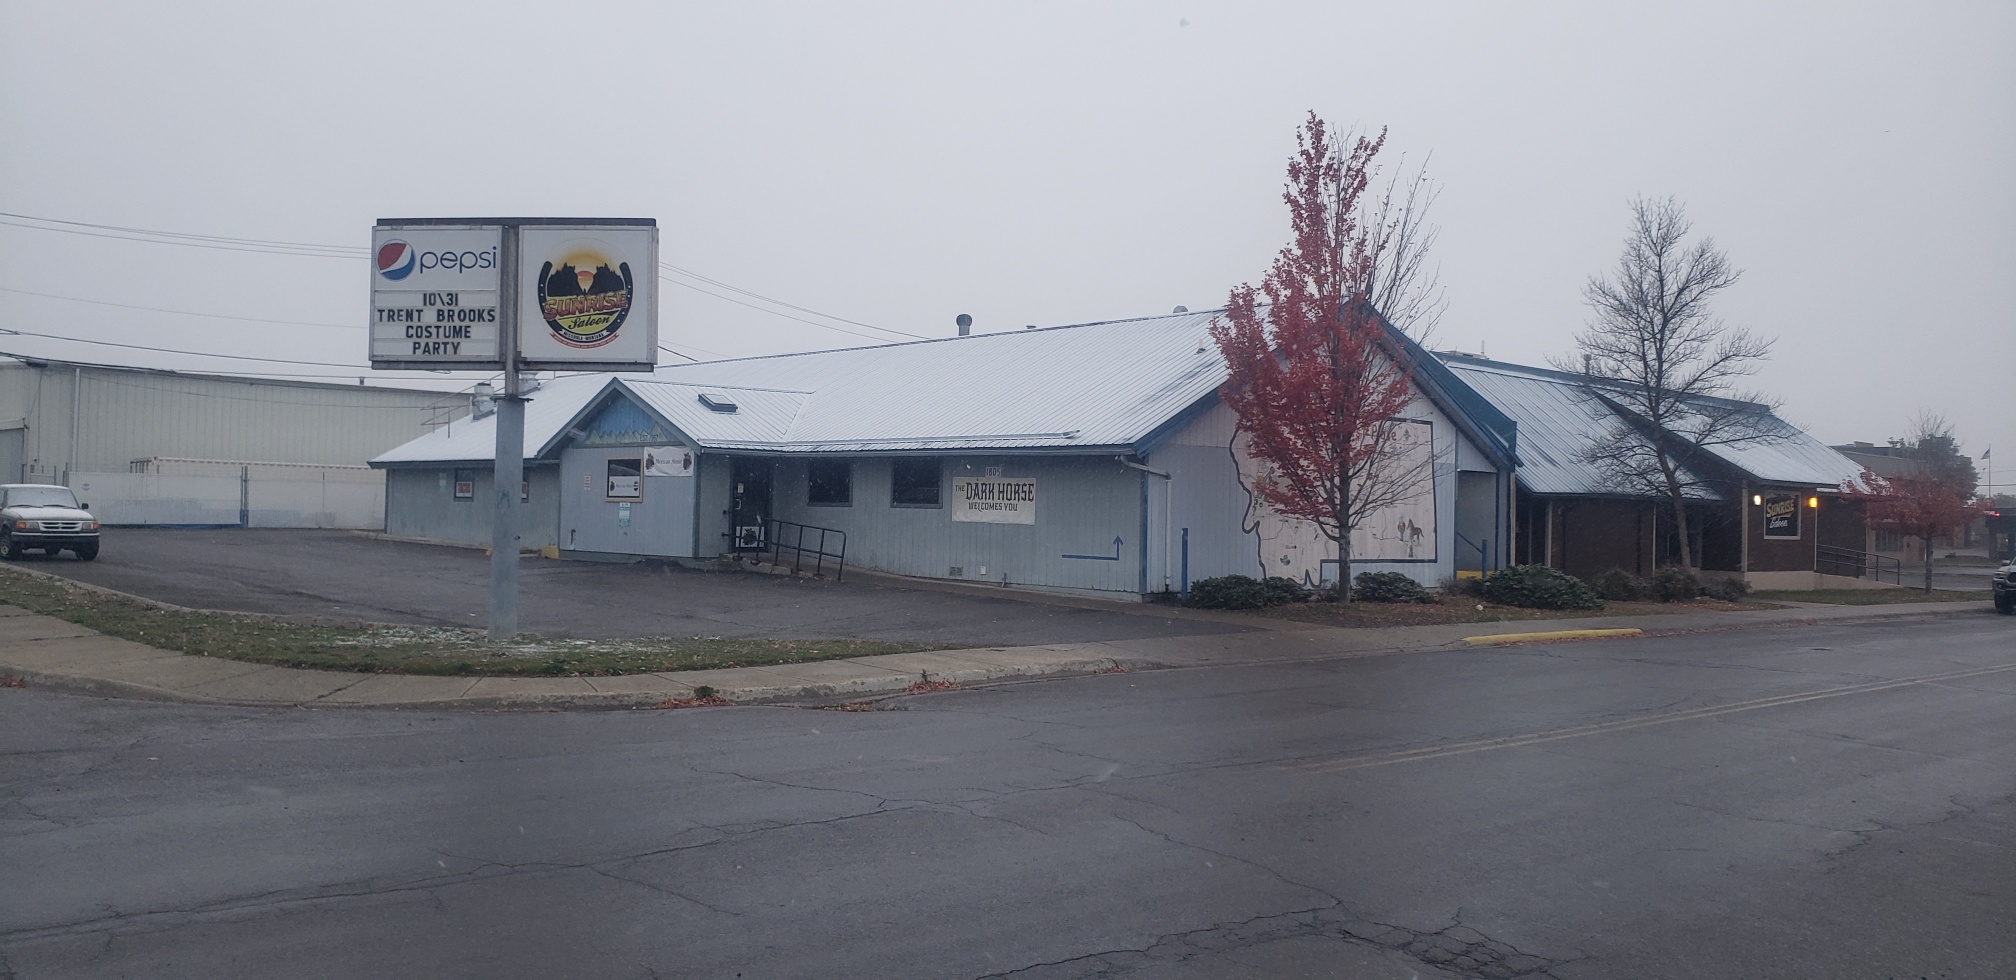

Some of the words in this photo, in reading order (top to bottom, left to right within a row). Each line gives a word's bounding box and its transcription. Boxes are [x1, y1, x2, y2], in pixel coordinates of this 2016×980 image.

[420, 246, 497, 274] pepsi
[543, 290, 627, 320] SUNRISE
[377, 309, 424, 322] TRENT
[436, 309, 496, 322] BROOKS
[568, 316, 610, 329] Saloon
[405, 325, 472, 339] COSTUME
[412, 341, 461, 355] PARTY
[986, 467, 1000, 477] 1805
[955, 484, 966, 492] THE
[966, 482, 995, 501] DARK
[998, 482, 1035, 502] HORSE
[968, 502, 1003, 512] WELCOMES
[1004, 503, 1018, 511] YOU
